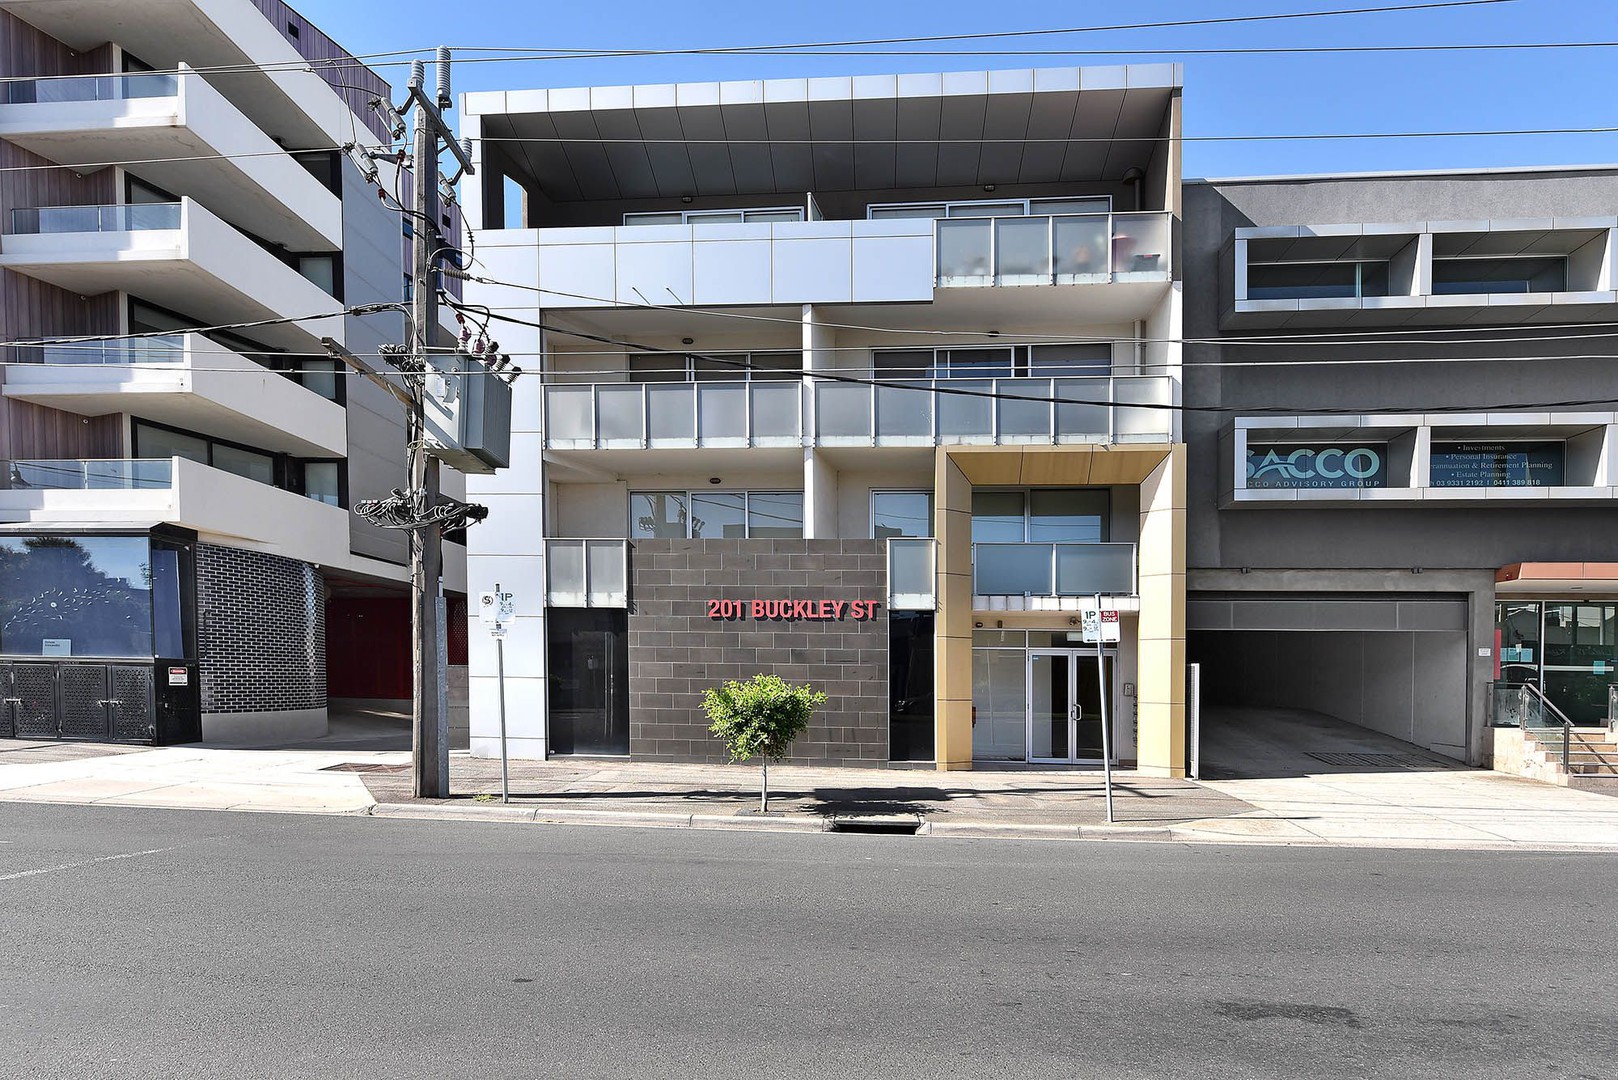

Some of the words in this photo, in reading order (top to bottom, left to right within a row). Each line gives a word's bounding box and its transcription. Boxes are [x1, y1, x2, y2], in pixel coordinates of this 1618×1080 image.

[1480, 461, 1520, 469] Retirement
[1521, 461, 1553, 470] Planning
[1480, 471, 1511, 479] Planning
[500, 592, 513, 601] 1P
[707, 599, 743, 619] 201
[751, 599, 845, 619] BUCKLEY
[850, 599, 878, 619] ST
[1085, 610, 1096, 619] 1P
